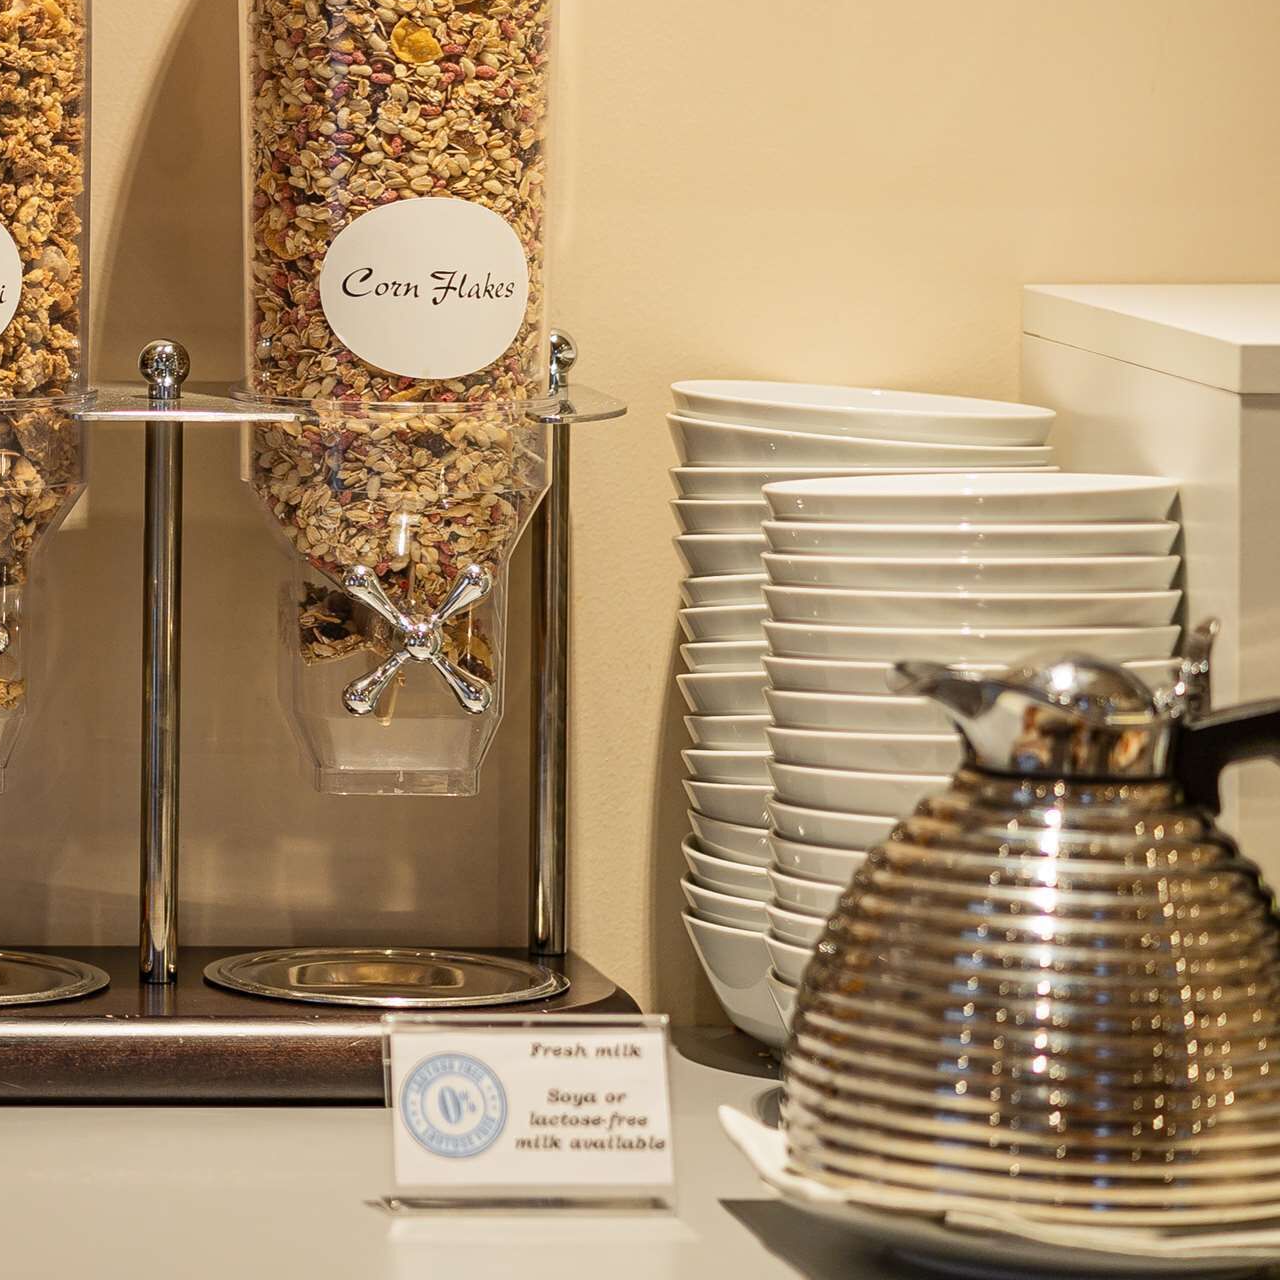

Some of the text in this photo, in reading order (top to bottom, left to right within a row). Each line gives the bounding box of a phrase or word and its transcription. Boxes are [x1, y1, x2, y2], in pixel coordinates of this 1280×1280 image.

[342, 267, 515, 306] Corn Flakes
[529, 1042, 642, 1058] Fresh milk
[547, 1088, 628, 1107] Soya or
[529, 1111, 648, 1130] lactose-free
[515, 1134, 665, 1150] milk available
